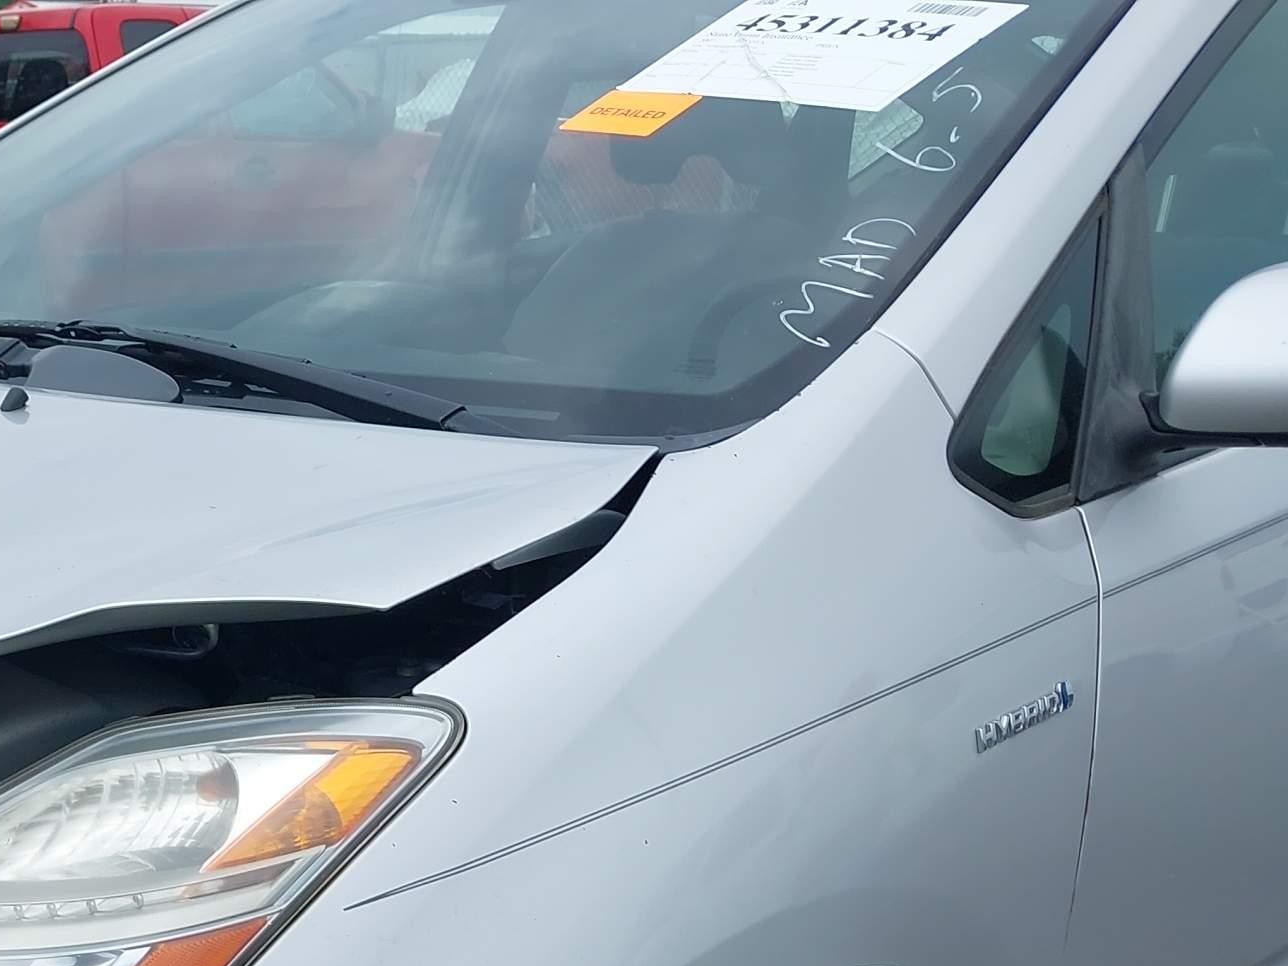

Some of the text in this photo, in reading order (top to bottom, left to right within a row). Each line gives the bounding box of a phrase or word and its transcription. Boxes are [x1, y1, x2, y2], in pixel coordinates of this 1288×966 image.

[735, 13, 956, 42] 45311384
[590, 106, 666, 120] DETAILED
[779, 217, 917, 348] MAD
[974, 690, 1062, 754] HYBRID
